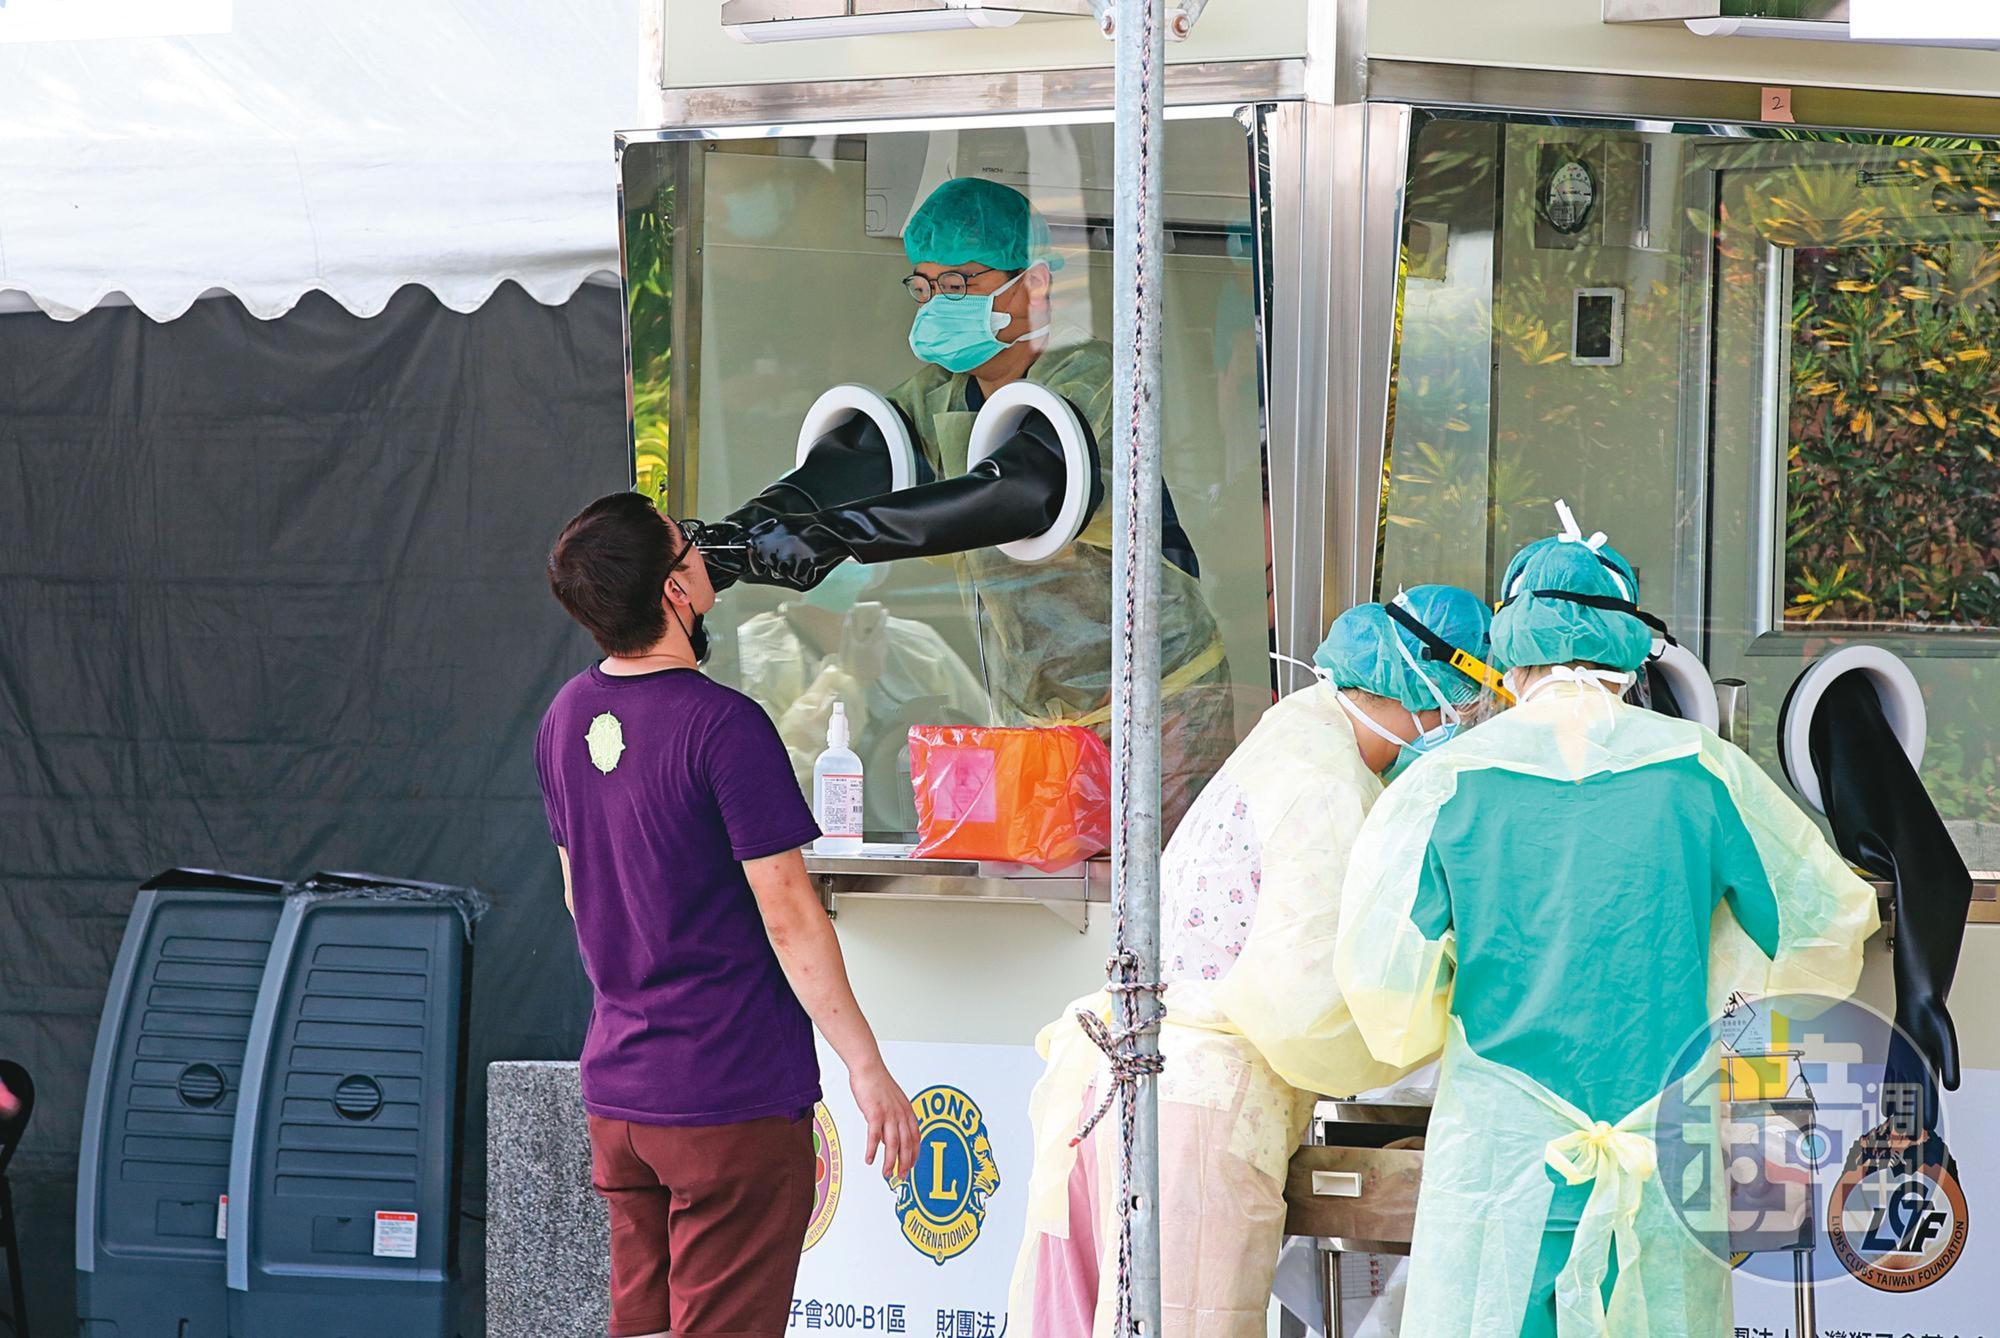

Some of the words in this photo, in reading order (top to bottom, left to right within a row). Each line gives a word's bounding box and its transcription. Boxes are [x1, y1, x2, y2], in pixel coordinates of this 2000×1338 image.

[1772, 96, 1784, 110] 2
[918, 1092, 976, 1130] IONS
[929, 1141, 958, 1200] L
[908, 1216, 973, 1249] INTERNATIONAL
[1831, 1216, 1848, 1253] LIONS
[1845, 1252, 1873, 1280] CLUBS
[1876, 1272, 1915, 1287] TAIWAN
[1917, 1220, 1964, 1283] FOUNDATION
